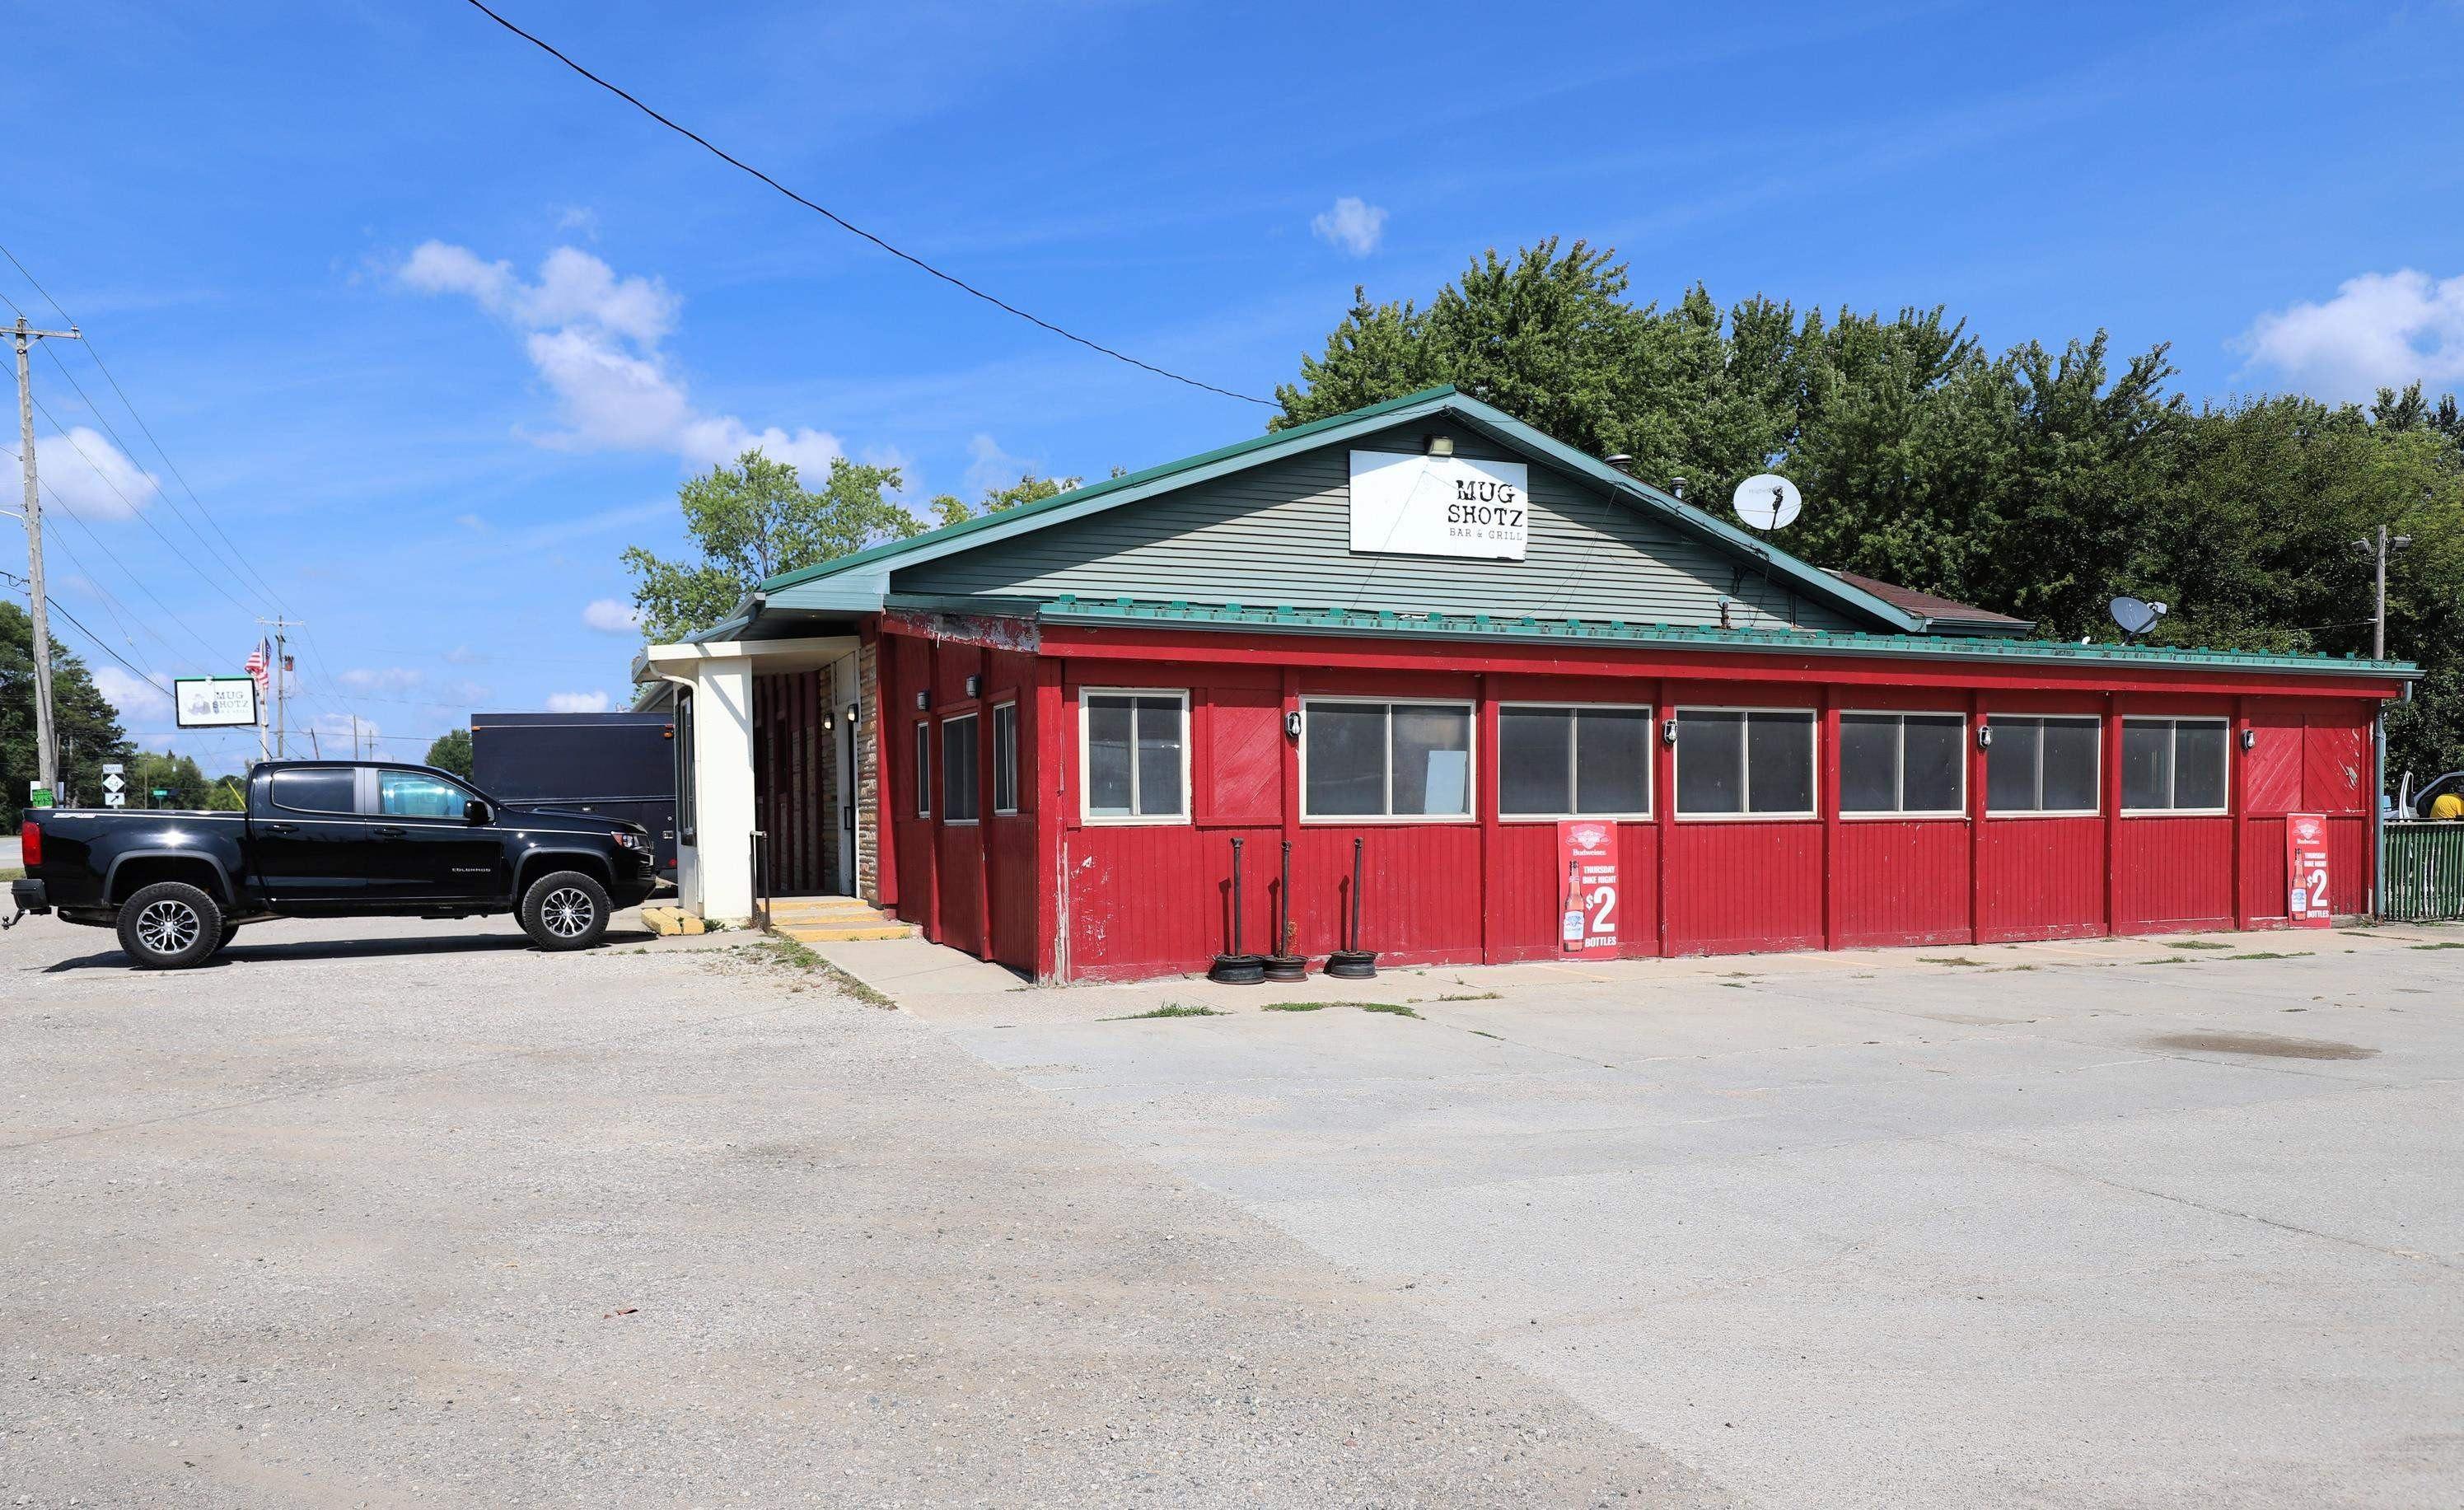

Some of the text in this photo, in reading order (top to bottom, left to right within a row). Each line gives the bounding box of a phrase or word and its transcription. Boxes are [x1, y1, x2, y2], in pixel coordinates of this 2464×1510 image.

[1456, 479, 1515, 503] MUG
[1447, 504, 1523, 526] SHOTZ
[1449, 527, 1523, 540] BAR & GRILL
[214, 691, 244, 699] MUG
[1584, 866, 1615, 874] THURSDAY
[1583, 876, 1616, 884] BIKE NIGHT
[2307, 869, 2327, 906] $2
[1586, 886, 1616, 932] $2
[1585, 937, 1617, 947] BOTTLES
